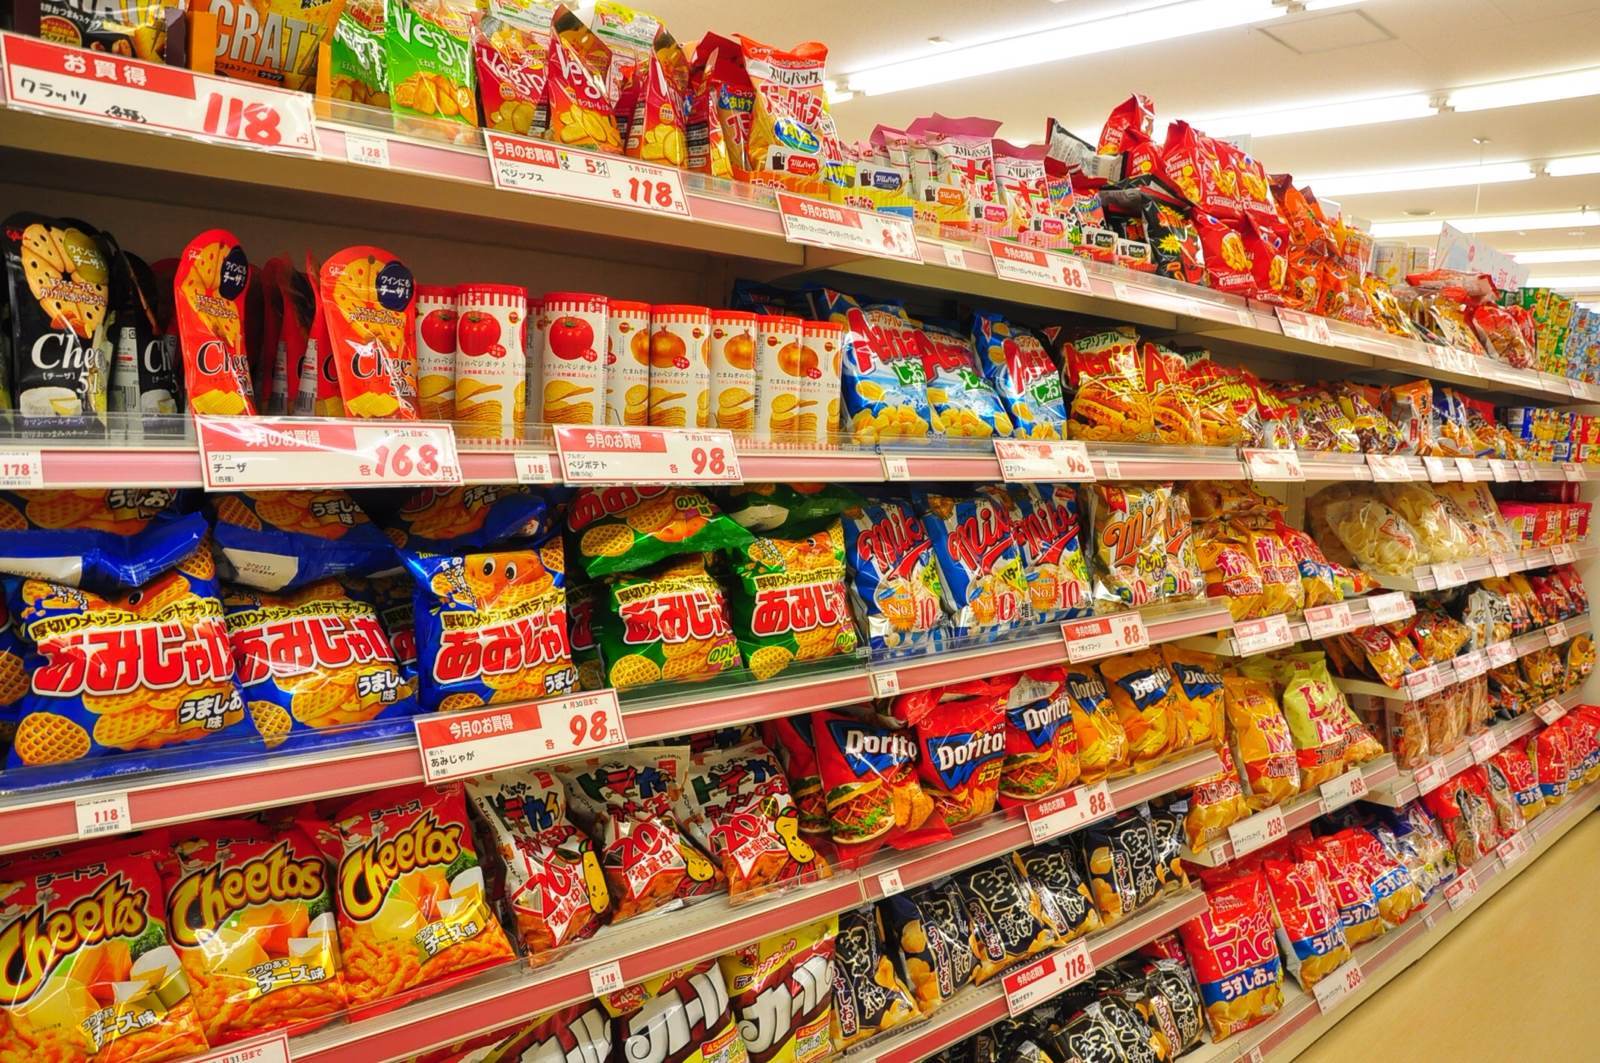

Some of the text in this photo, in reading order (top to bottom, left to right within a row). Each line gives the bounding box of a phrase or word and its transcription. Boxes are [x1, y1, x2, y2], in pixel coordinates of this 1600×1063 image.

[64, 53, 147, 86] お買得
[203, 92, 281, 146] 118
[361, 146, 381, 158] 128
[493, 141, 556, 164] 今月のお買得
[585, 159, 597, 173] 5
[629, 177, 672, 207] 118
[1062, 267, 1082, 288] 88
[1074, 333, 1119, 351] エアリアル
[585, 433, 641, 449] 今月のお買得
[4, 464, 30, 476] 178
[213, 463, 246, 474] チーザ
[360, 464, 371, 476] 各
[375, 444, 439, 478] 168
[527, 464, 545, 474] 118
[568, 461, 607, 470] ベジポテト
[691, 447, 725, 475] 98
[1060, 580, 1082, 609] 10
[919, 597, 939, 630] 10
[1123, 624, 1140, 645] 88
[206, 717, 223, 730] 味
[450, 714, 513, 740] 今月のお買得
[545, 739, 555, 750] 各
[570, 711, 608, 746] 98
[431, 751, 475, 768] あみじゃが
[1089, 791, 1106, 815] 88
[94, 809, 118, 823] 118
[1266, 816, 1282, 837] 238
[338, 808, 463, 922] Cheetos
[167, 840, 325, 947] Cheetos
[0, 871, 148, 1008] Cheetos
[1214, 931, 1275, 976] BAG
[1065, 954, 1086, 980] 118
[601, 973, 616, 985] 118
